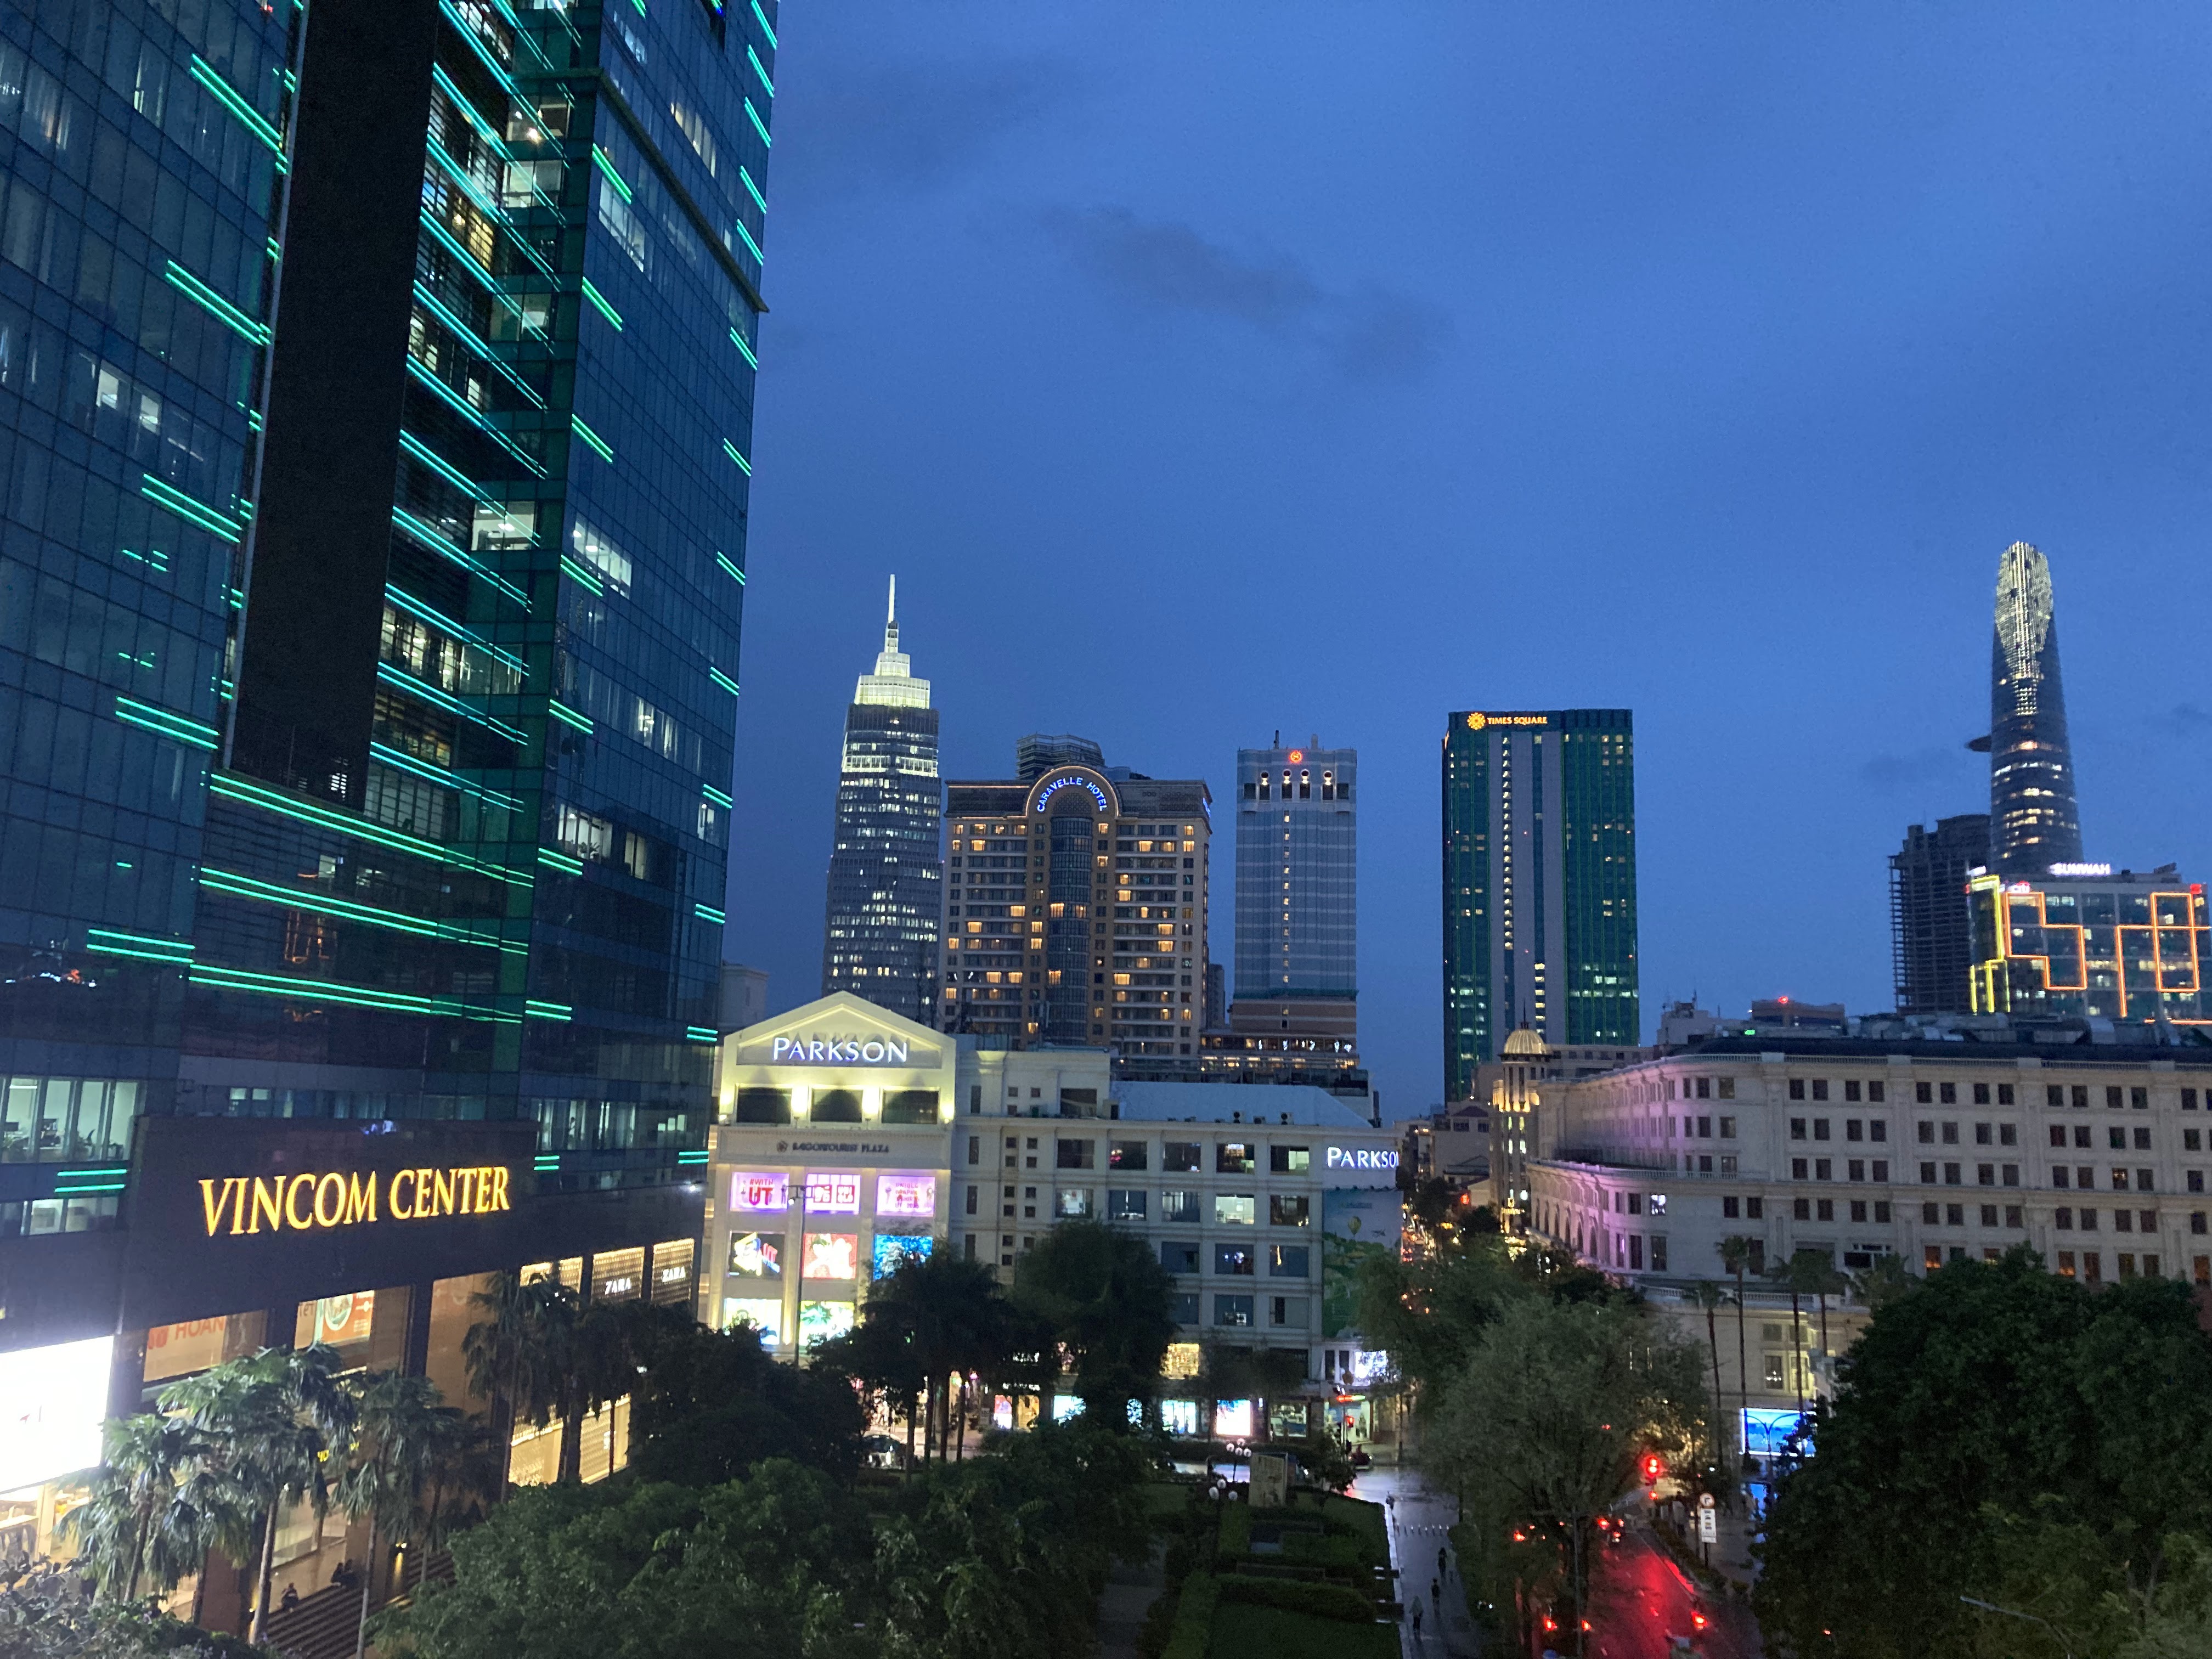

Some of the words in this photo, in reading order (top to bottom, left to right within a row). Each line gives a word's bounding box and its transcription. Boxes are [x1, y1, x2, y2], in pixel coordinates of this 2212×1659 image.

[1487, 716, 1512, 725] TIMES
[1514, 716, 1548, 725] SQUARE
[1037, 776, 1083, 812] CARAVELLE
[1086, 782, 1107, 811] HOTEL
[2052, 863, 2111, 875] SUNWAH
[773, 1037, 908, 1063] PARKSON
[199, 1171, 377, 1237] VINCOM
[390, 1166, 511, 1220] CENTER
[748, 1187, 774, 1206] UT
[662, 1266, 686, 1282] ZARA
[605, 1277, 631, 1295] ZARA
